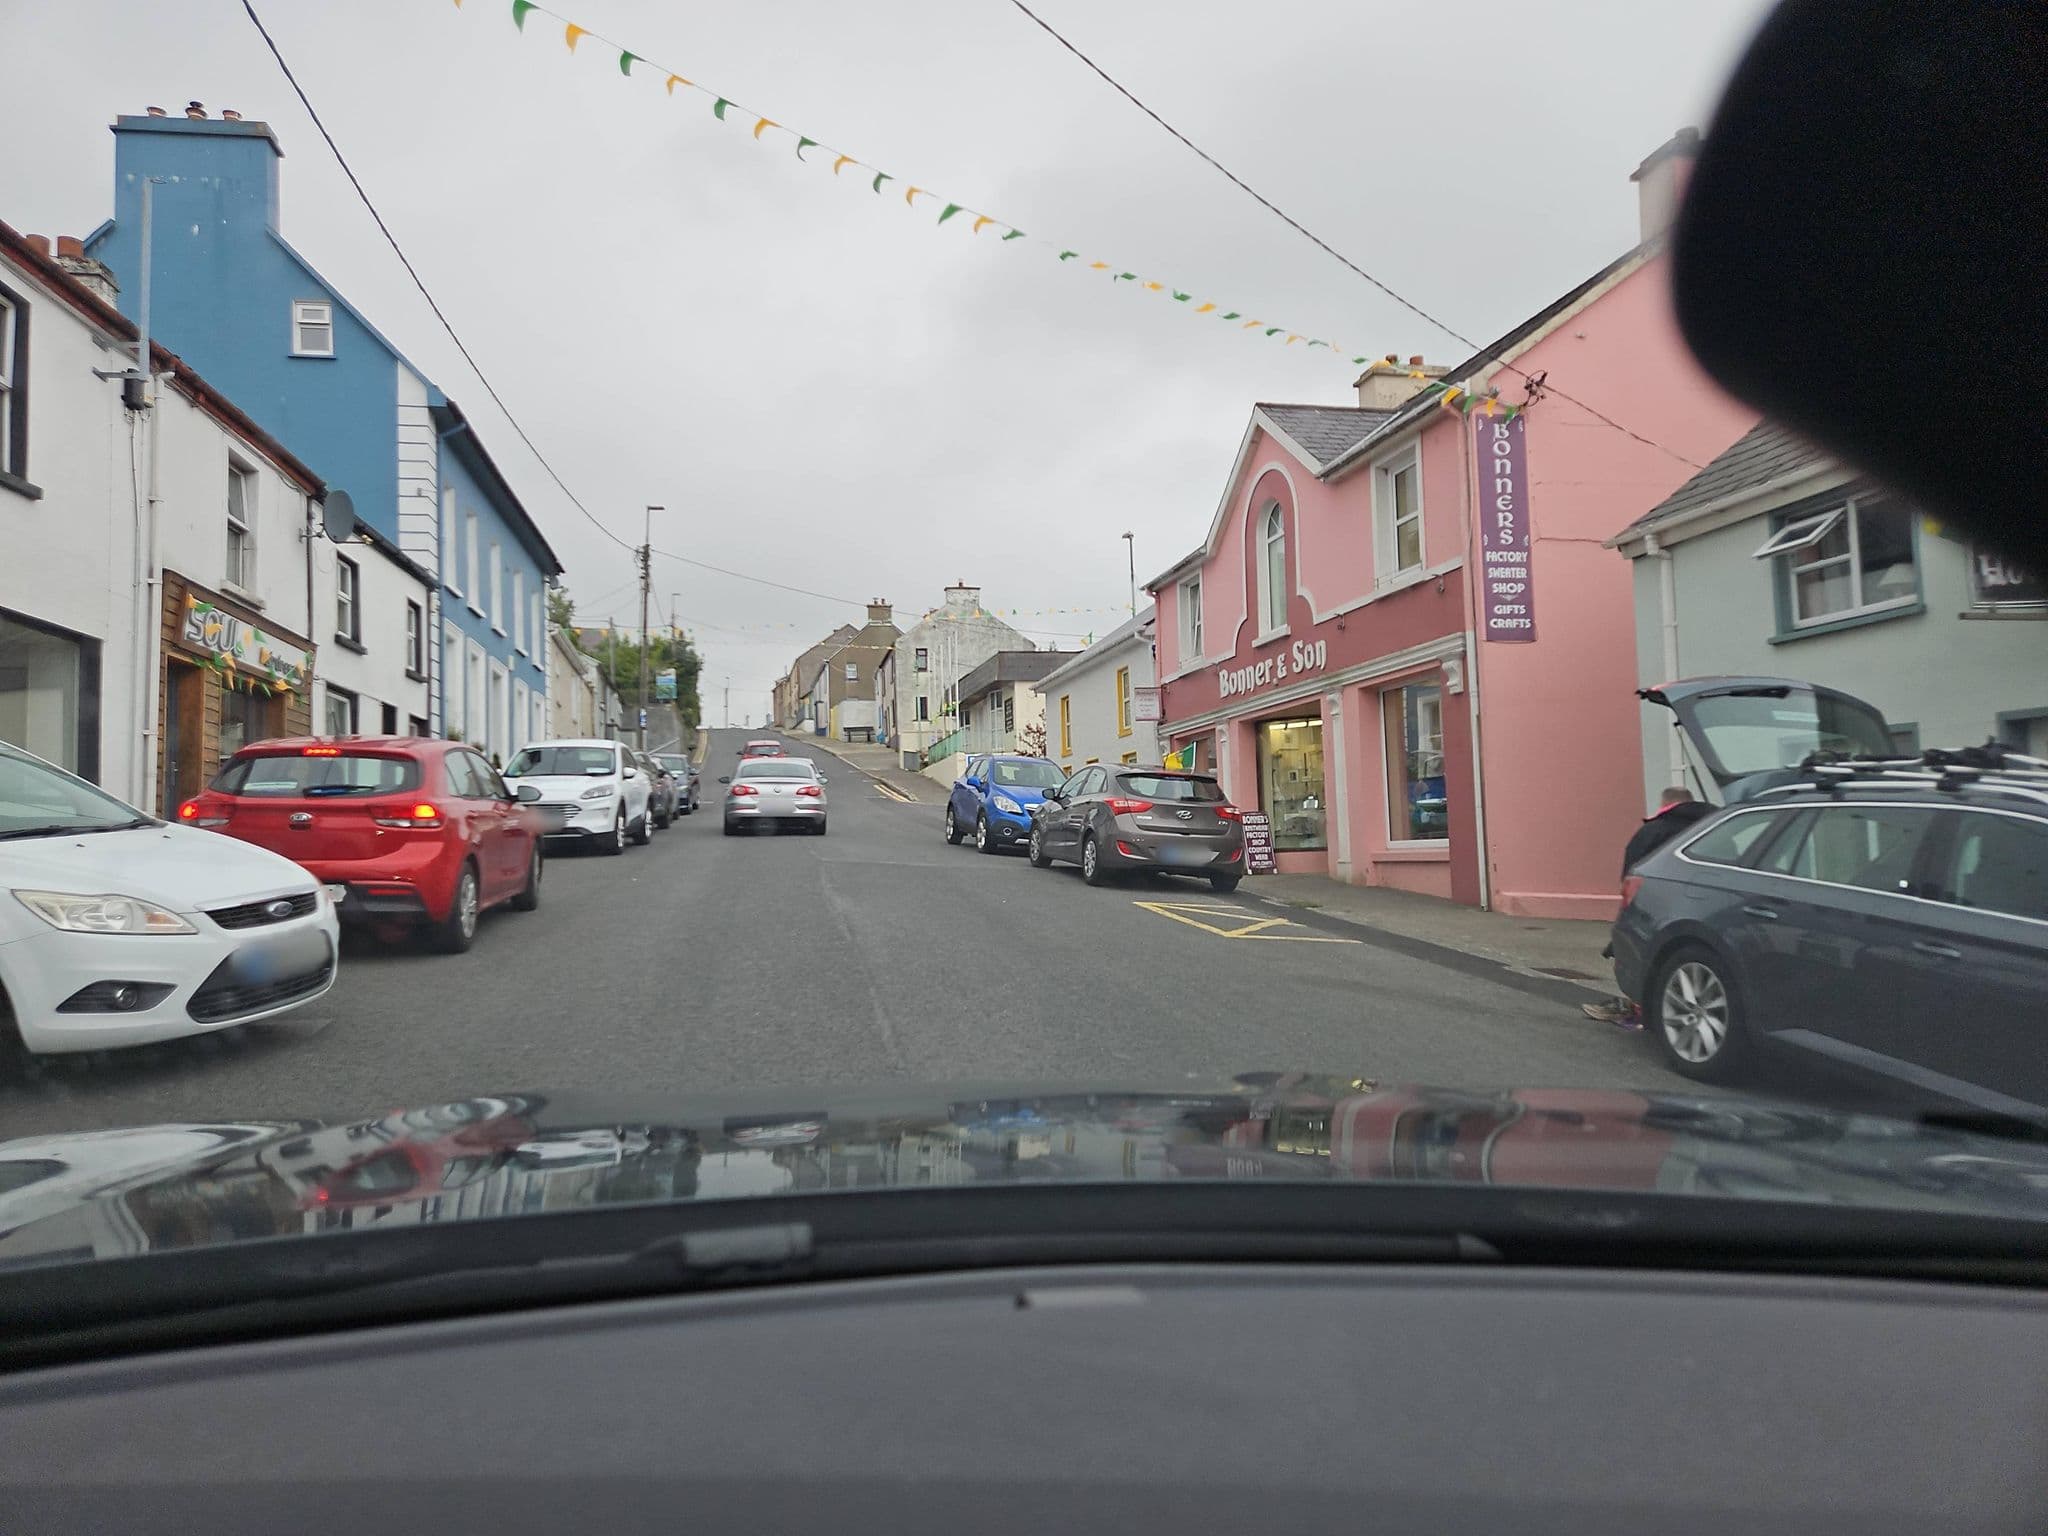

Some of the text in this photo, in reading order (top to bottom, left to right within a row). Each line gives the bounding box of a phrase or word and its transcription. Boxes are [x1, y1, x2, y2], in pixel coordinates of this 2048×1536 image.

[1486, 551, 1528, 562] FACTORY
[1488, 568, 1527, 578] SWEATER
[1492, 583, 1525, 593] SHOP
[1494, 605, 1526, 614] GIFTS
[1490, 618, 1531, 628] CRAFTS
[1218, 639, 1327, 699] Bonner & Son
